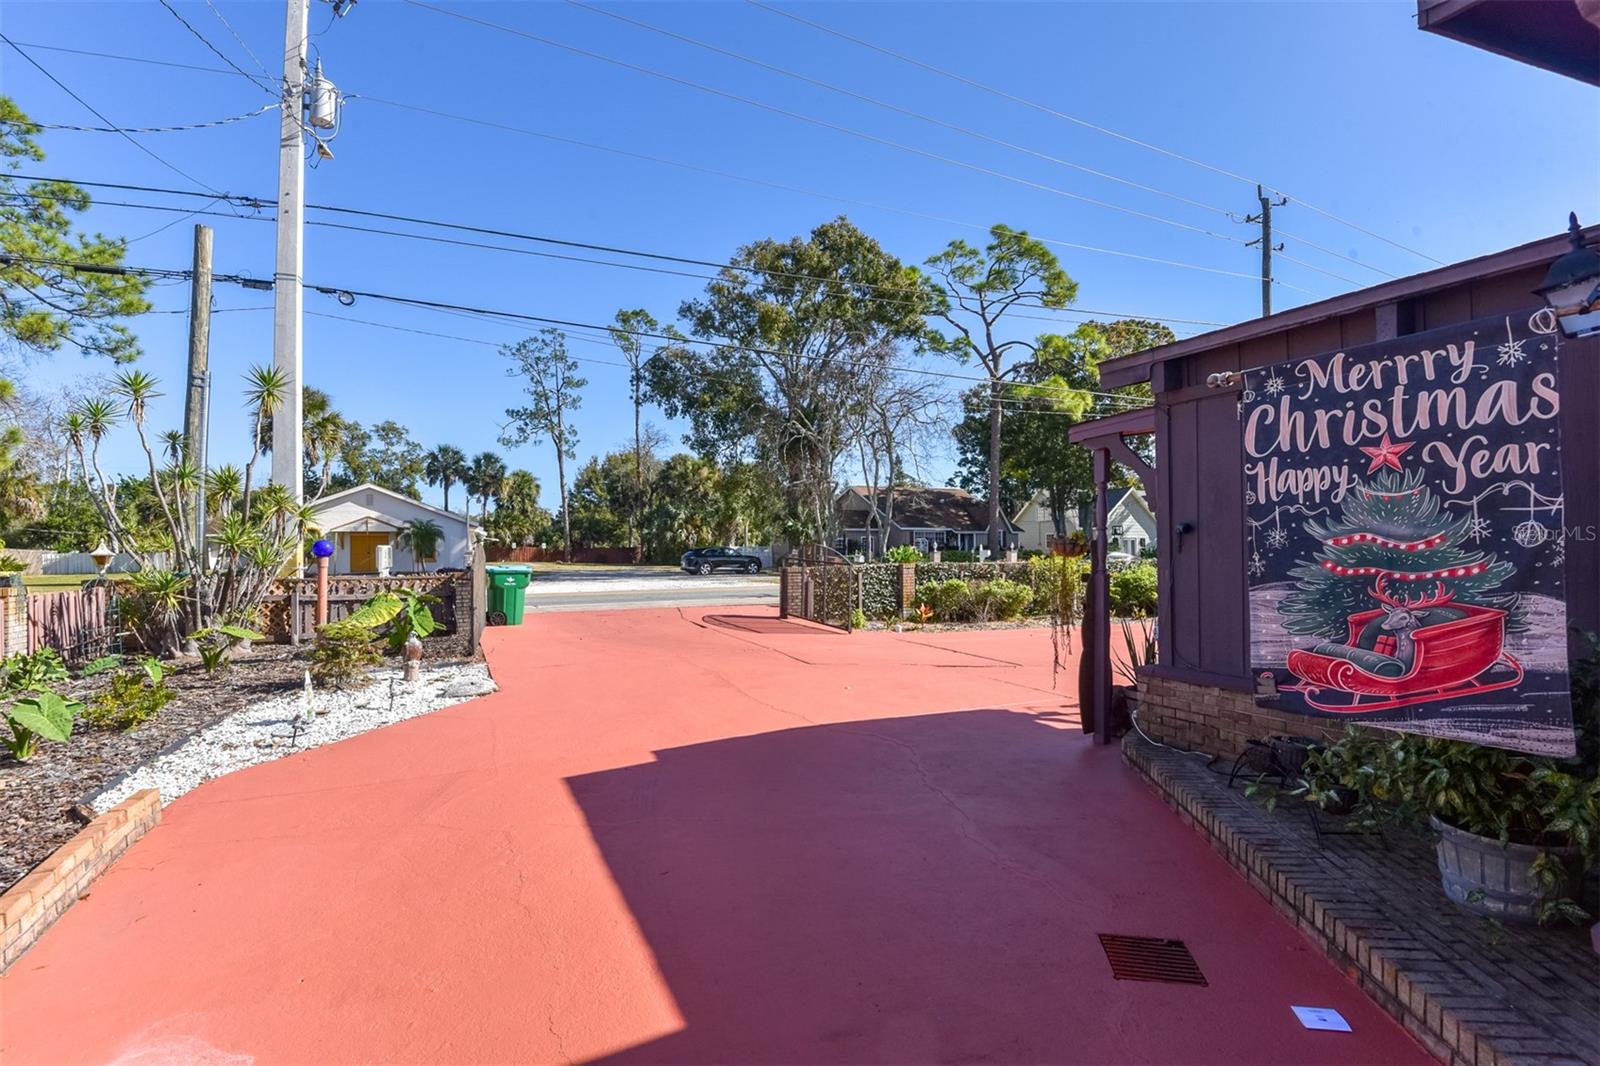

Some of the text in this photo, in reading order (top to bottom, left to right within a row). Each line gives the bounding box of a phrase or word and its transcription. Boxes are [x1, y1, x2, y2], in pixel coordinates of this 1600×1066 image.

[1295, 341, 1489, 400] Merrry
[1244, 373, 1560, 457] Christmas
[1244, 435, 1550, 504] Happy Year
